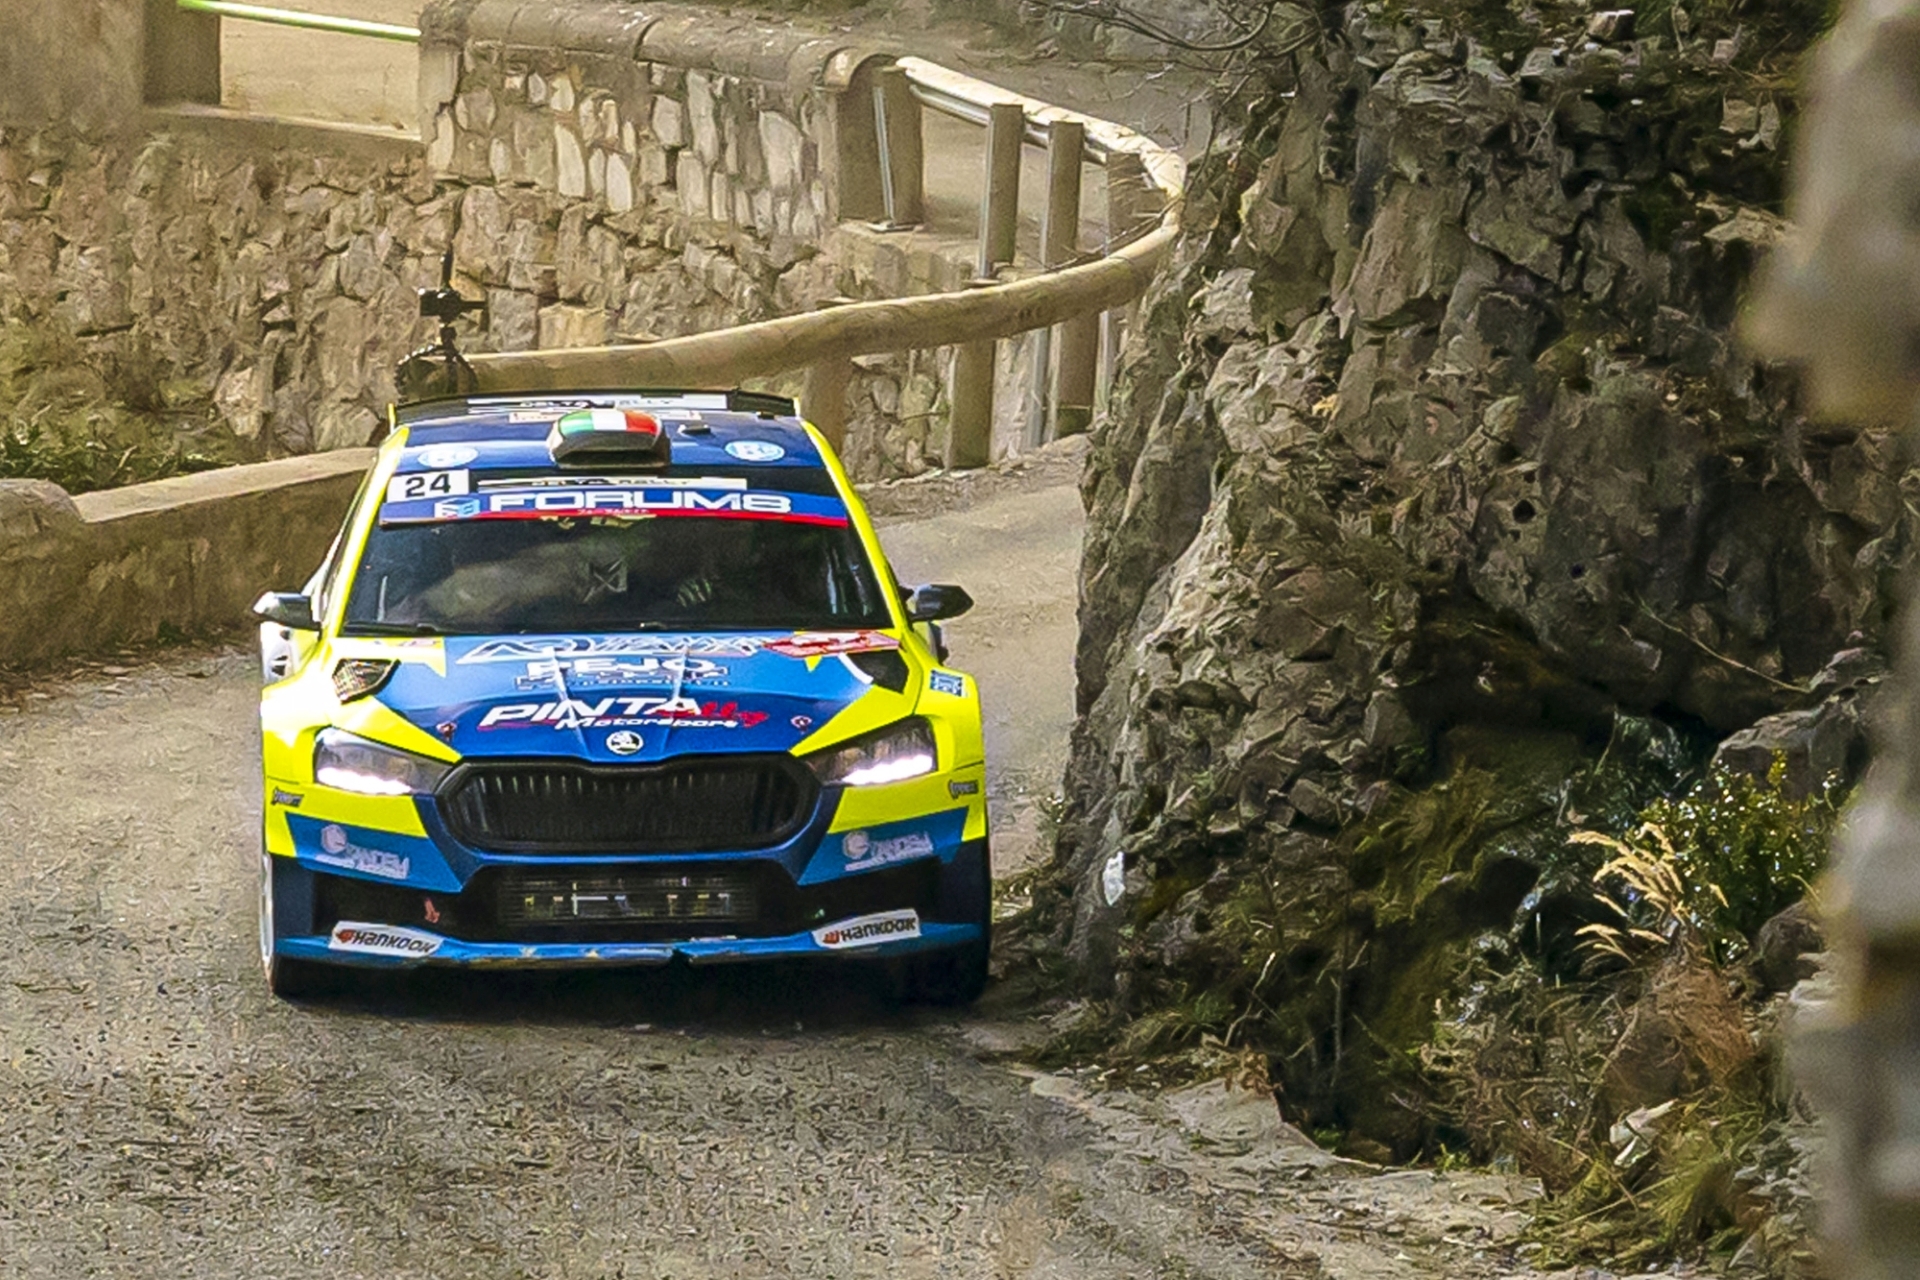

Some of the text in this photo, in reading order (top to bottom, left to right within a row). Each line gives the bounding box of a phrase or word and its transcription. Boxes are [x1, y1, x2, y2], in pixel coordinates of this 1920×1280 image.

[405, 473, 451, 498] 24
[490, 490, 792, 513] FORUM8
[555, 717, 738, 731] Motorsport
